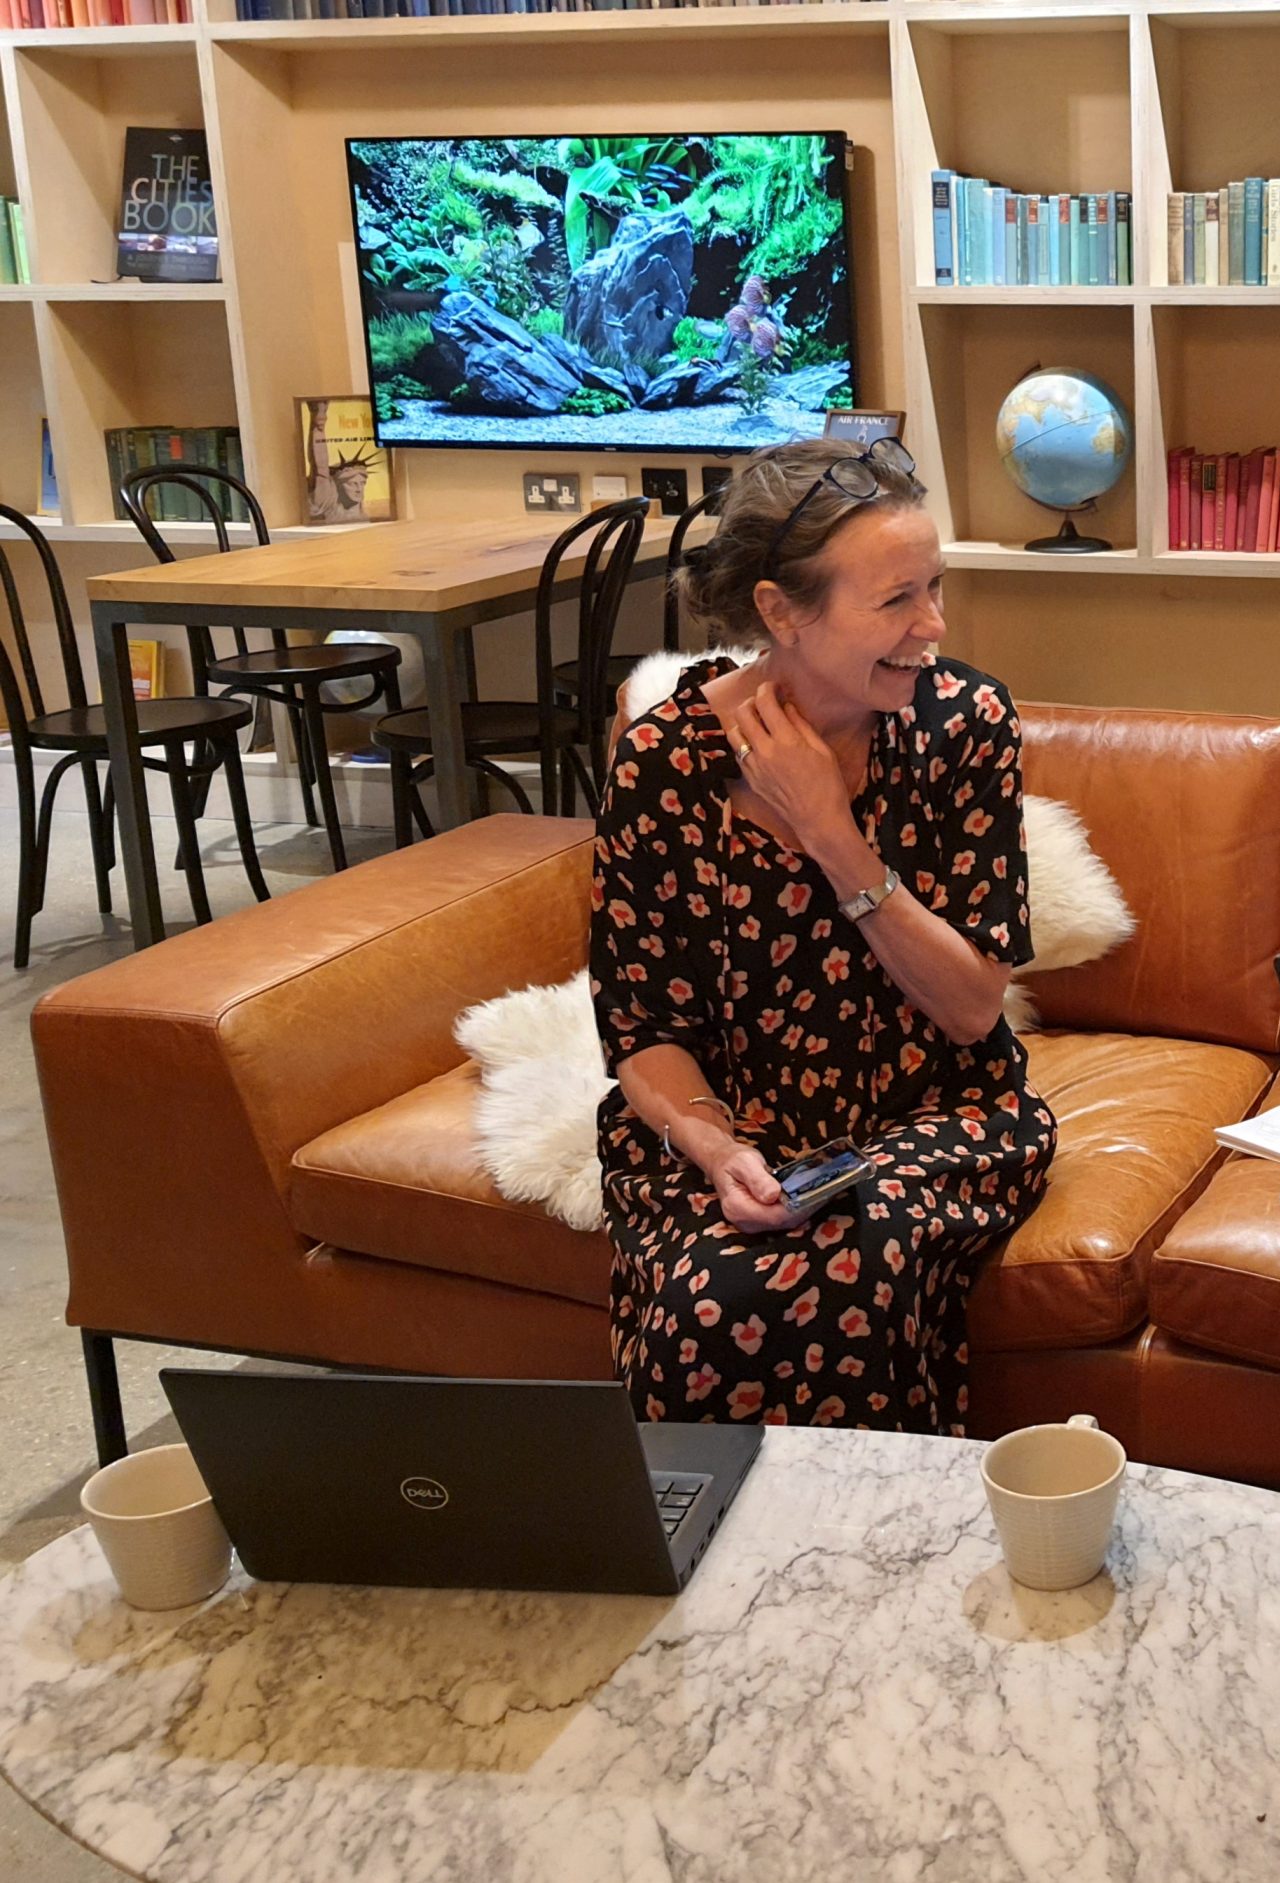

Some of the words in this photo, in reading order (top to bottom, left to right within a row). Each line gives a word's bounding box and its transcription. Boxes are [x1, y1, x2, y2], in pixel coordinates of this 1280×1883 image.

[152, 154, 200, 182] THE
[131, 177, 212, 207] CITIES
[123, 199, 215, 235] BOOK
[360, 412, 373, 429] Yo
[838, 415, 853, 425] AIR
[854, 416, 888, 425] FRANCE
[406, 1488, 444, 1498] DELL
